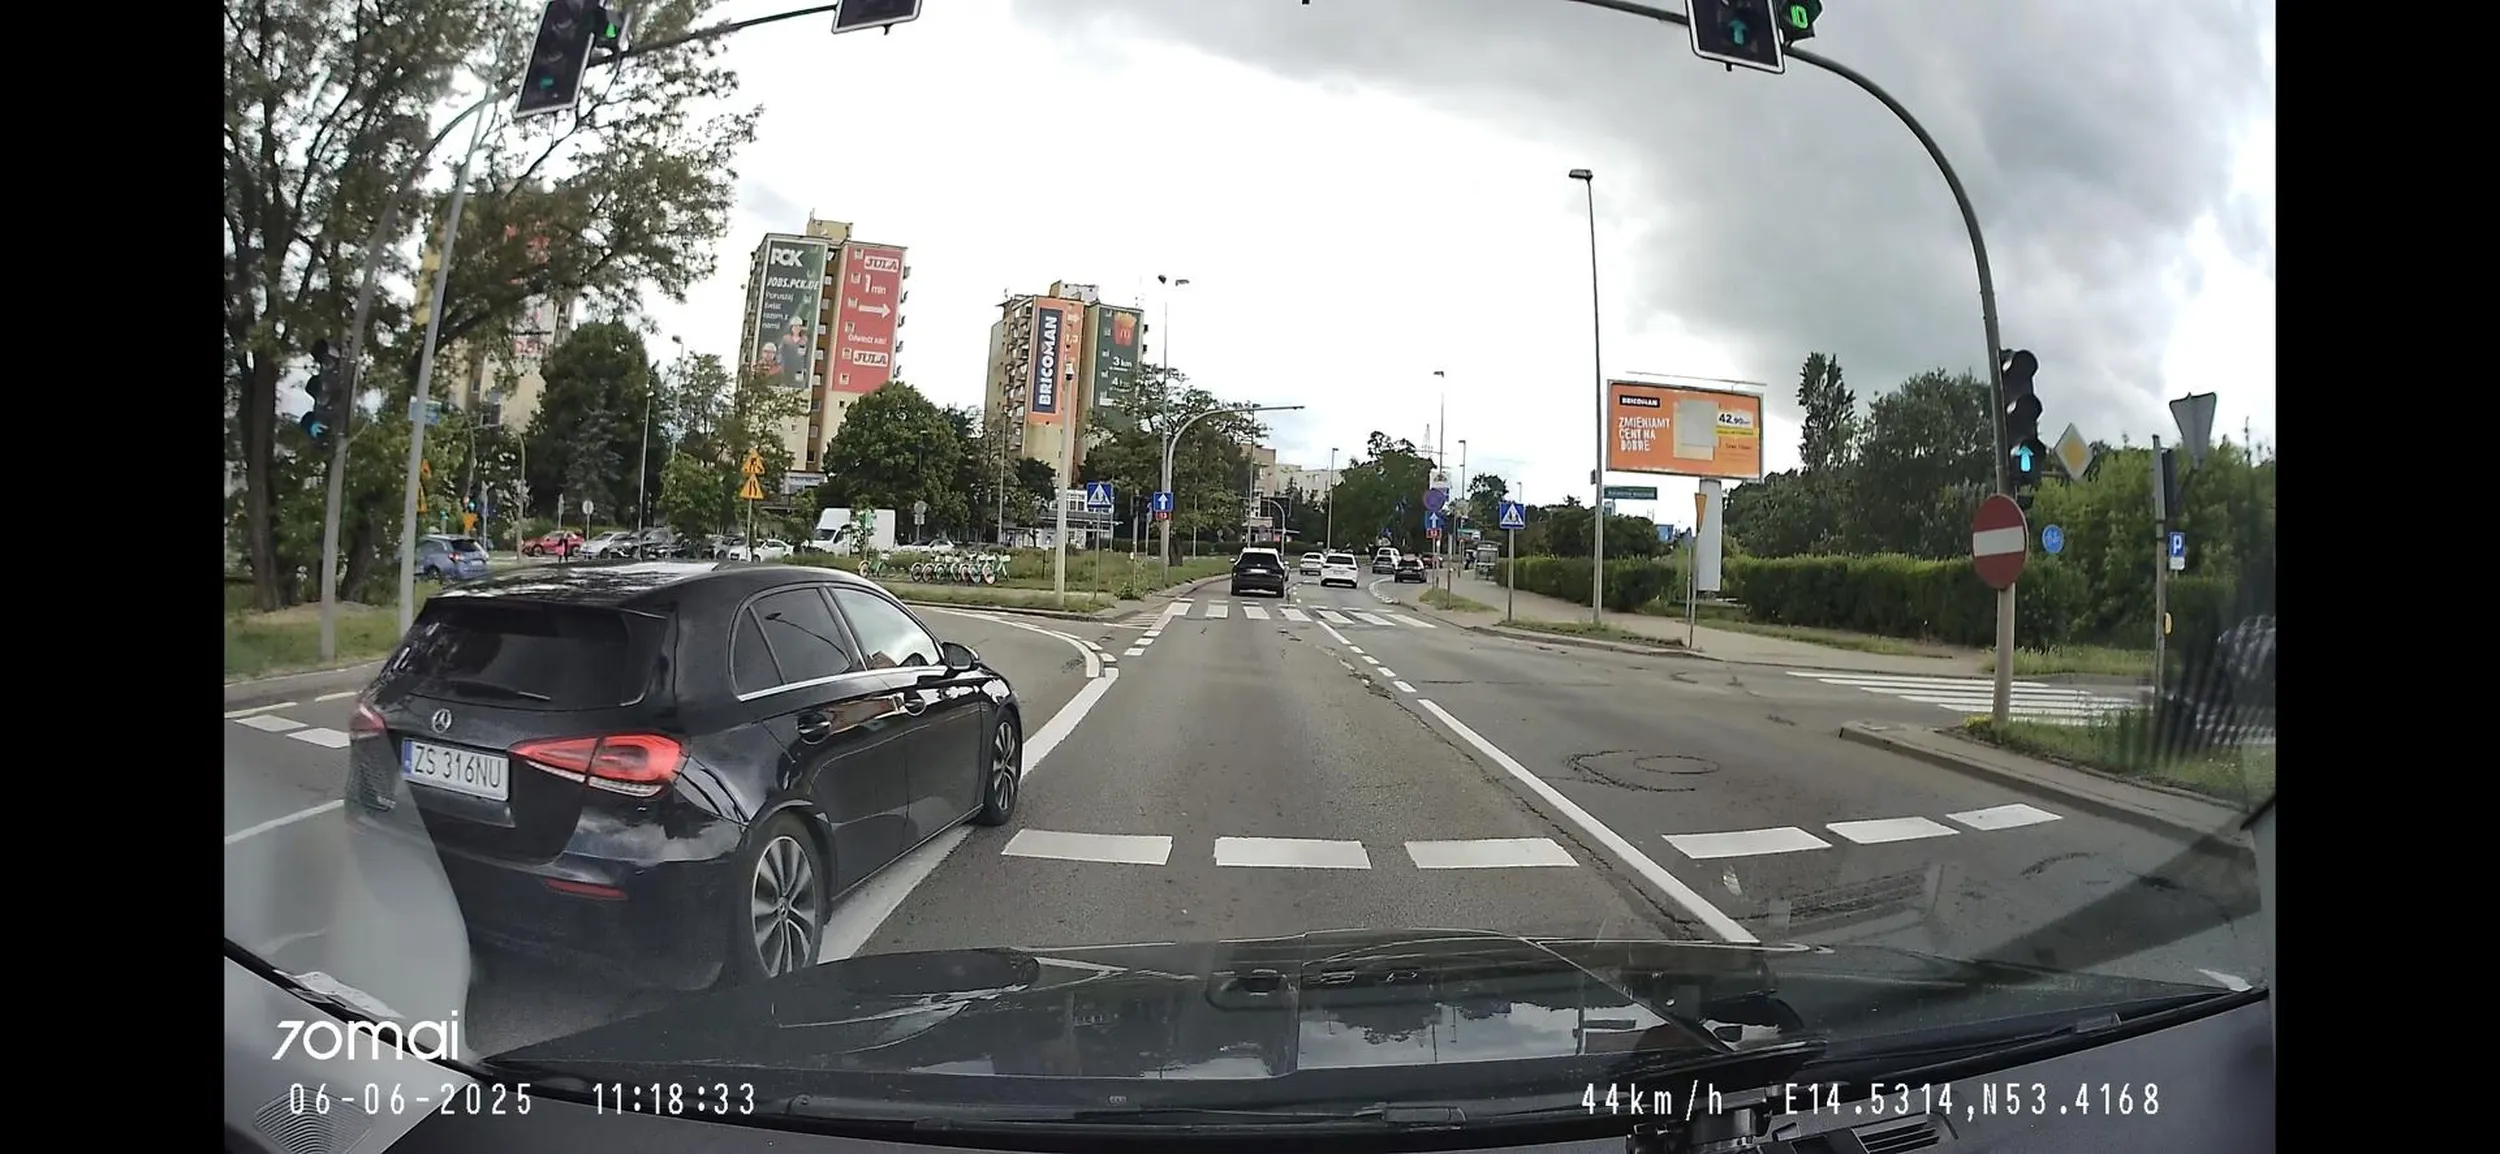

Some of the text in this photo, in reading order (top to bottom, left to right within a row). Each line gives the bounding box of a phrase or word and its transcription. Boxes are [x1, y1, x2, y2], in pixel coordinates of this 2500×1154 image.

[770, 247, 804, 267] PCK
[865, 257, 898, 271] JULA
[865, 274, 872, 293] 1
[854, 352, 887, 365] JULA
[1038, 315, 1058, 406] BRICOMAN
[1112, 356, 1133, 368] 3 km
[1111, 377, 1119, 386] 4
[2173, 534, 2182, 555] P
[414, 745, 501, 788] ZS 316NU
